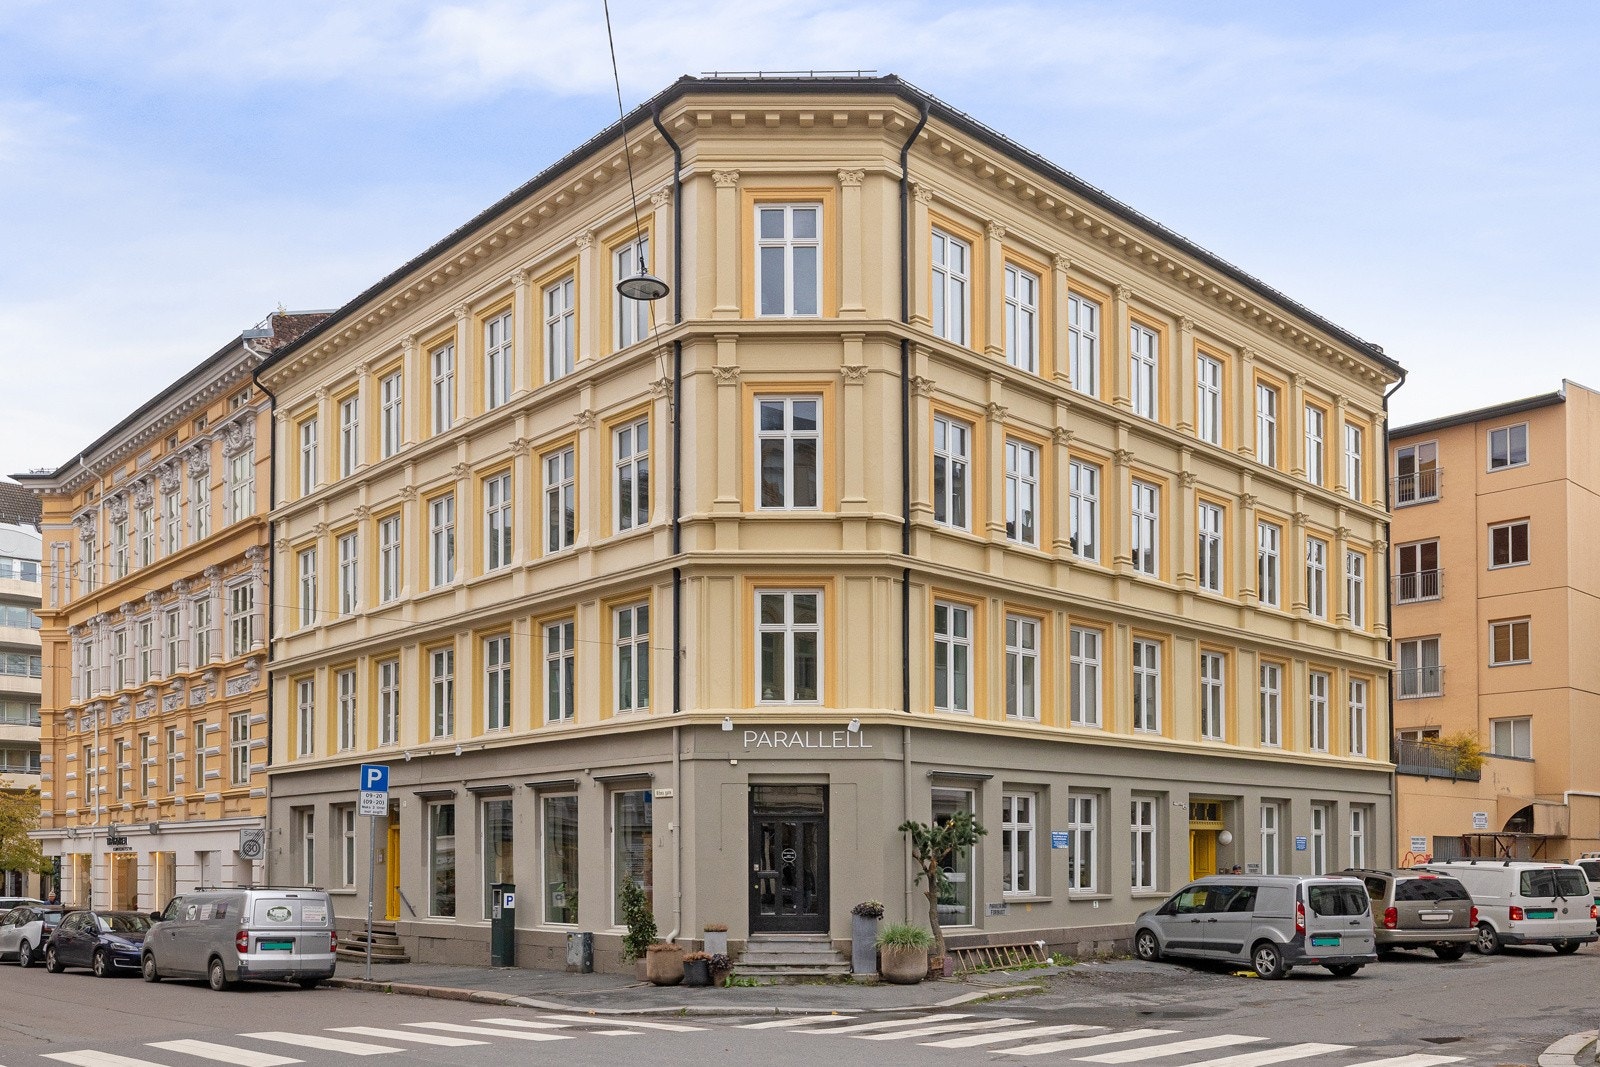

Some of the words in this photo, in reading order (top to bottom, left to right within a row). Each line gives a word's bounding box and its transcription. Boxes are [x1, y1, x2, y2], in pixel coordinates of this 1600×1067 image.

[743, 730, 873, 748] PARALLELL
[368, 768, 382, 788] P
[506, 895, 514, 906] P
